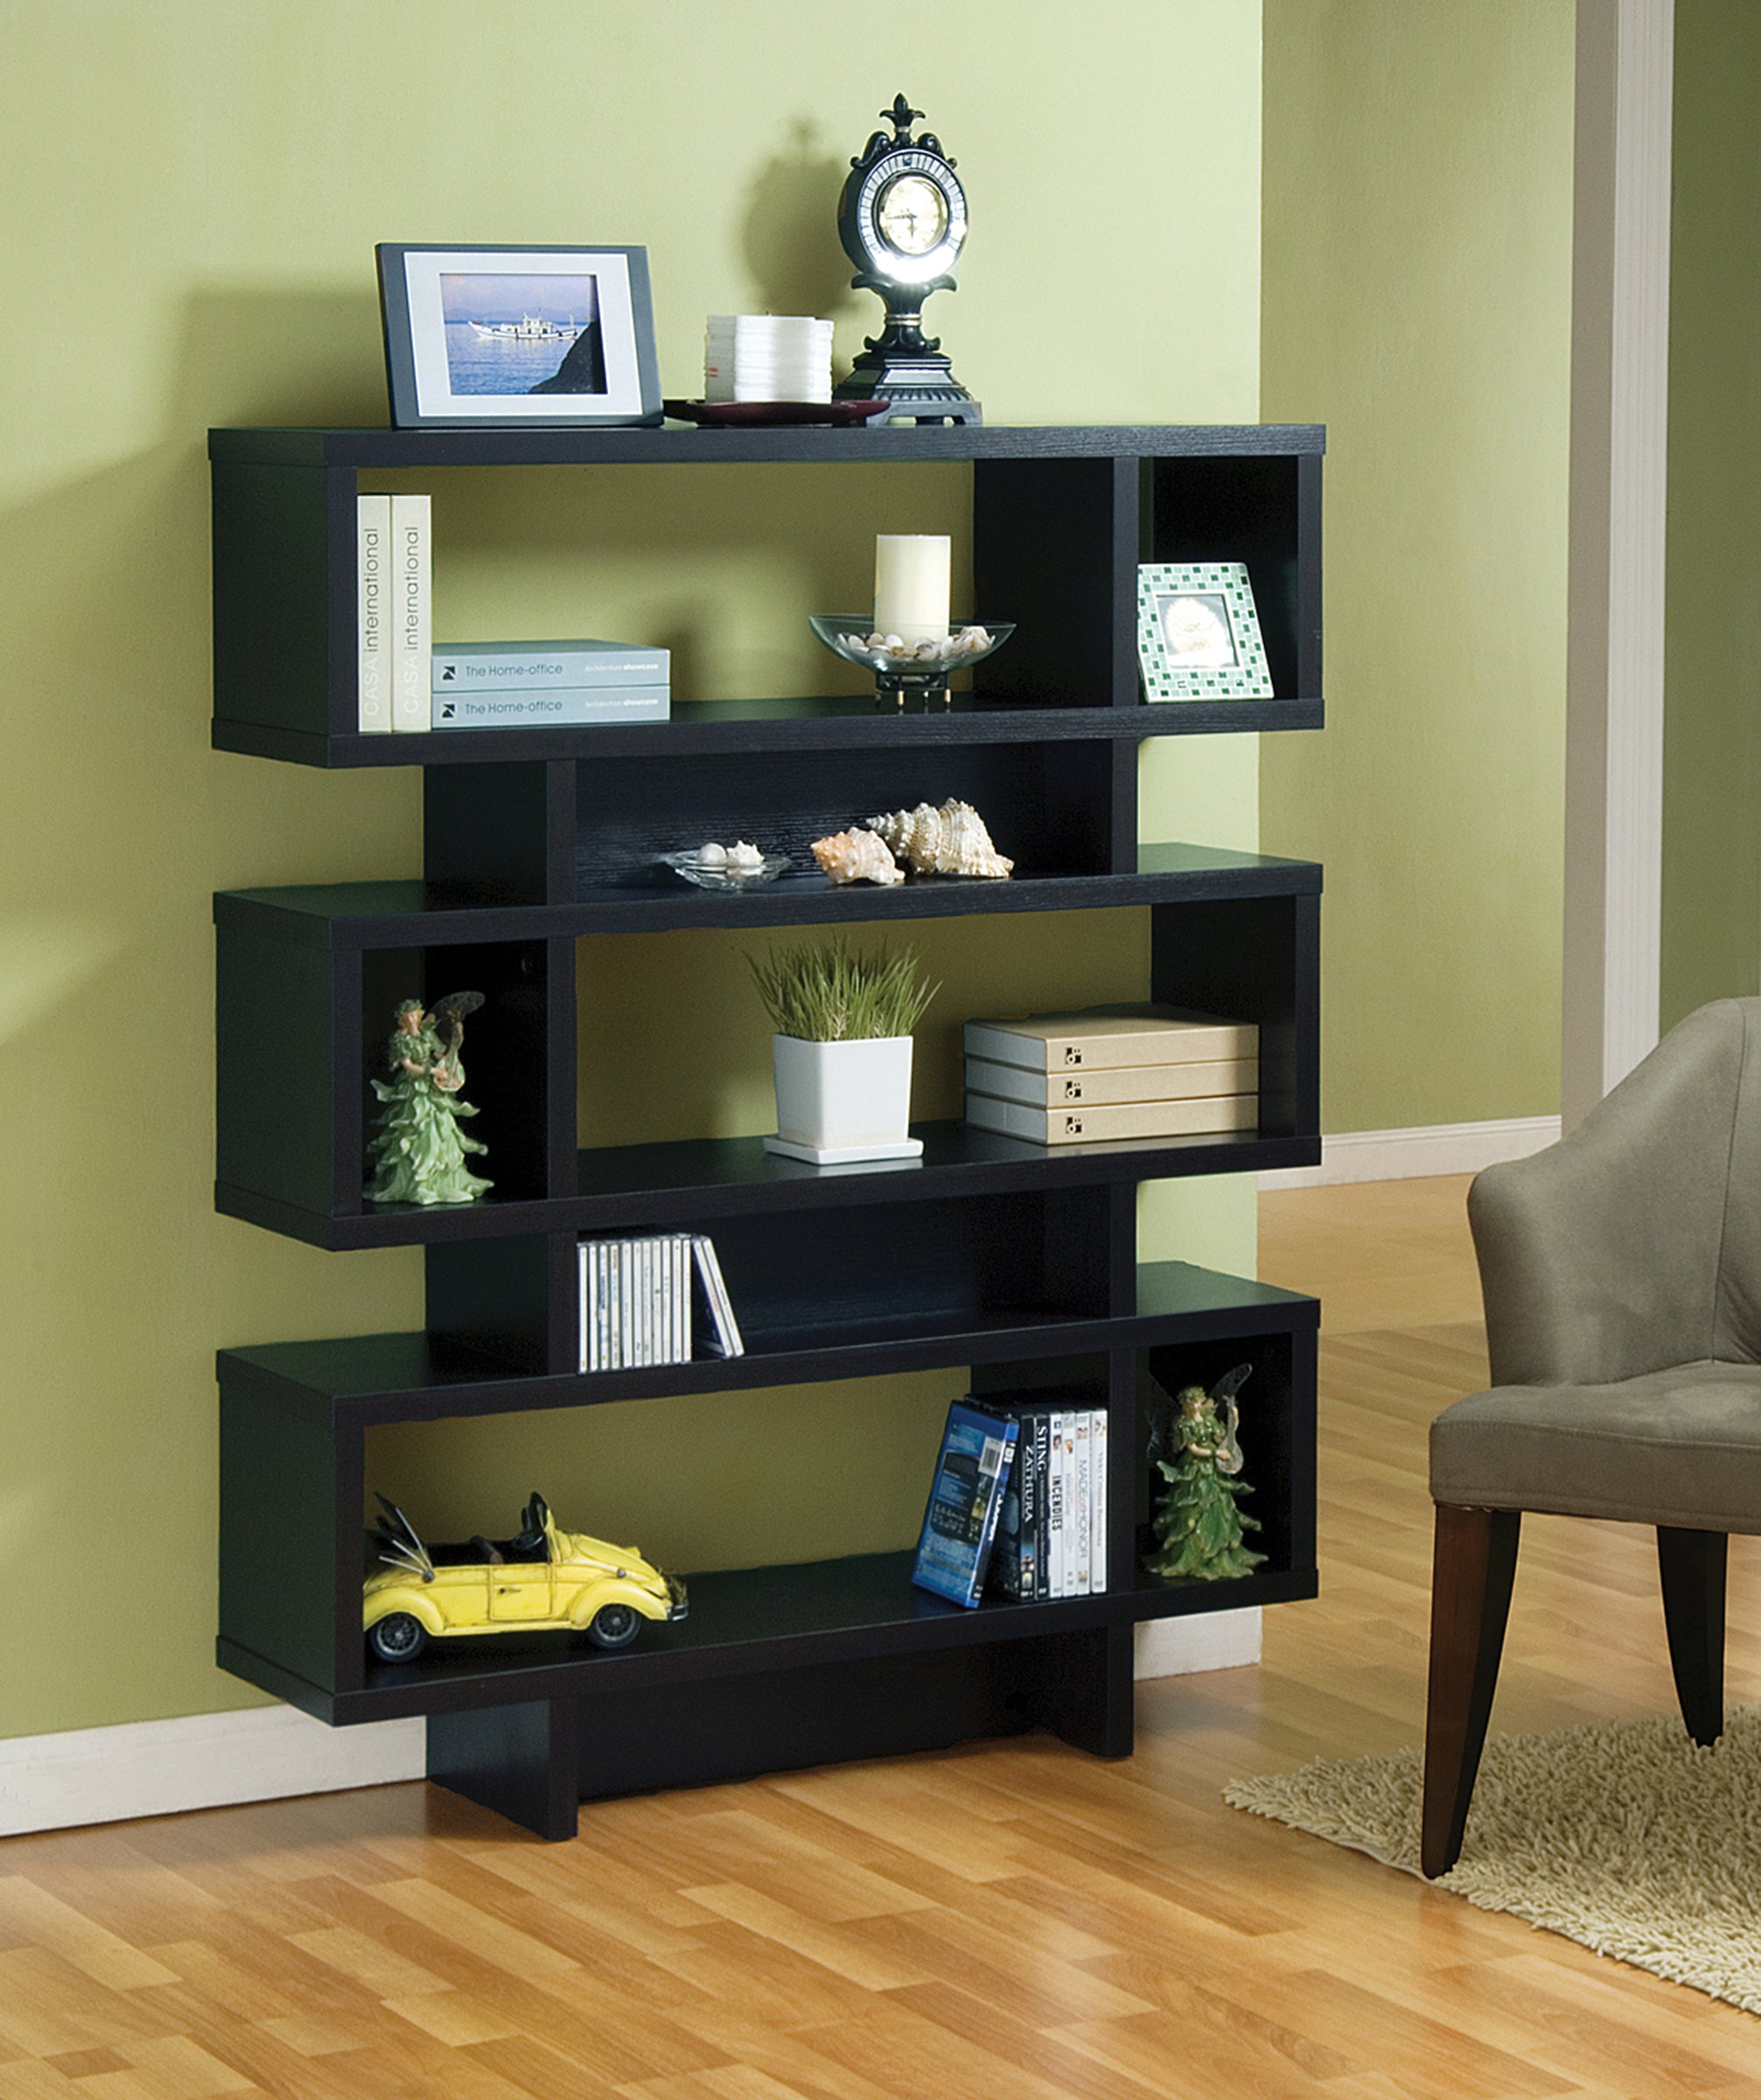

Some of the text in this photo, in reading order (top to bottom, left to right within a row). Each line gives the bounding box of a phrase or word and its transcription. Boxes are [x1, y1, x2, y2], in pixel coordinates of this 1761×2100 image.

[364, 528, 379, 716] CASA international
[403, 527, 418, 714] CASA international
[465, 664, 563, 676] The Home-office
[465, 701, 563, 714] The Home-office
[1037, 1425, 1047, 1471] STING
[1024, 1445, 1035, 1522] ZATHURA
[1052, 1475, 1062, 1531] INCENDIES
